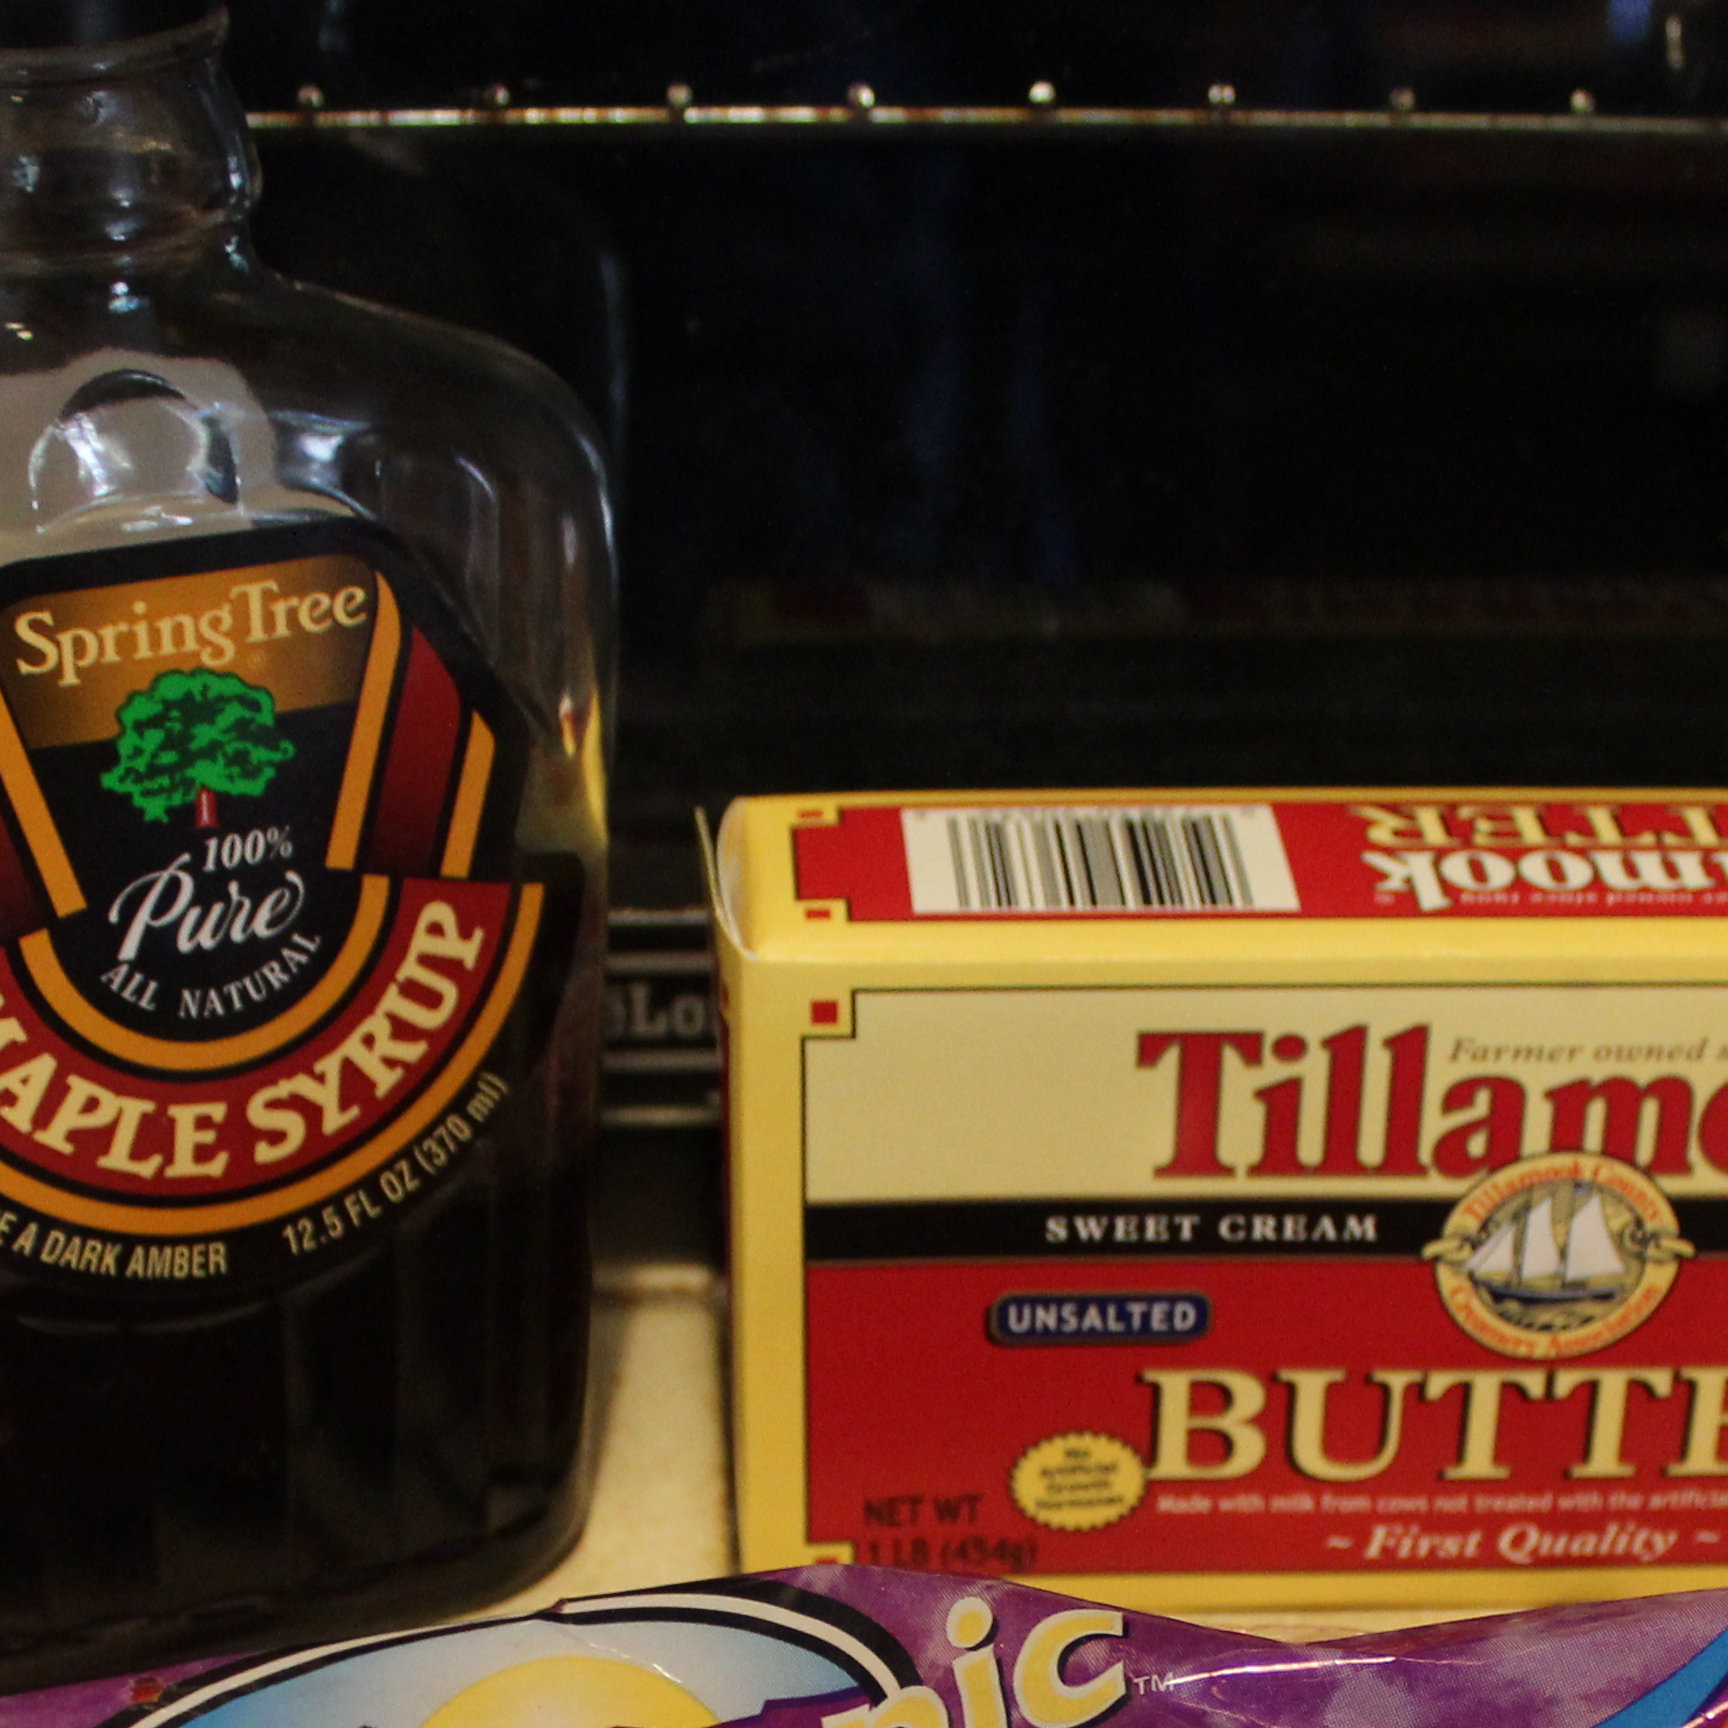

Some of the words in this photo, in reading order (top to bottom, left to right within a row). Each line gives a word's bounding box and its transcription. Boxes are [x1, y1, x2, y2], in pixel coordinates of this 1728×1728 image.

[203, 825, 293, 872] 100%
[108, 853, 305, 962] Pure
[100, 962, 160, 1012] ALL
[178, 933, 322, 1019] NATURAL
[244, 899, 485, 1165] SYRUP
[1448, 1036, 1585, 1064] Farmer
[1593, 1037, 1706, 1064] owned
[281, 1207, 345, 1257] 12.5
[344, 1189, 384, 1229] FL
[379, 1159, 423, 1205] OZ
[415, 1108, 474, 1182] (370
[470, 1072, 512, 1128] ml)
[12, 1221, 38, 1257] A
[39, 1229, 120, 1277] DARK
[125, 1241, 228, 1280] AMBER
[1045, 1213, 1200, 1245] SWEET
[1218, 1212, 1378, 1244] CREAM
[1007, 1301, 1198, 1334] UNSALTED
[864, 1494, 926, 1527] NET
[934, 1493, 985, 1525] WT
[893, 1537, 931, 1570] LB
[1364, 1523, 1482, 1560] First
[1497, 1520, 1678, 1564] Quality
